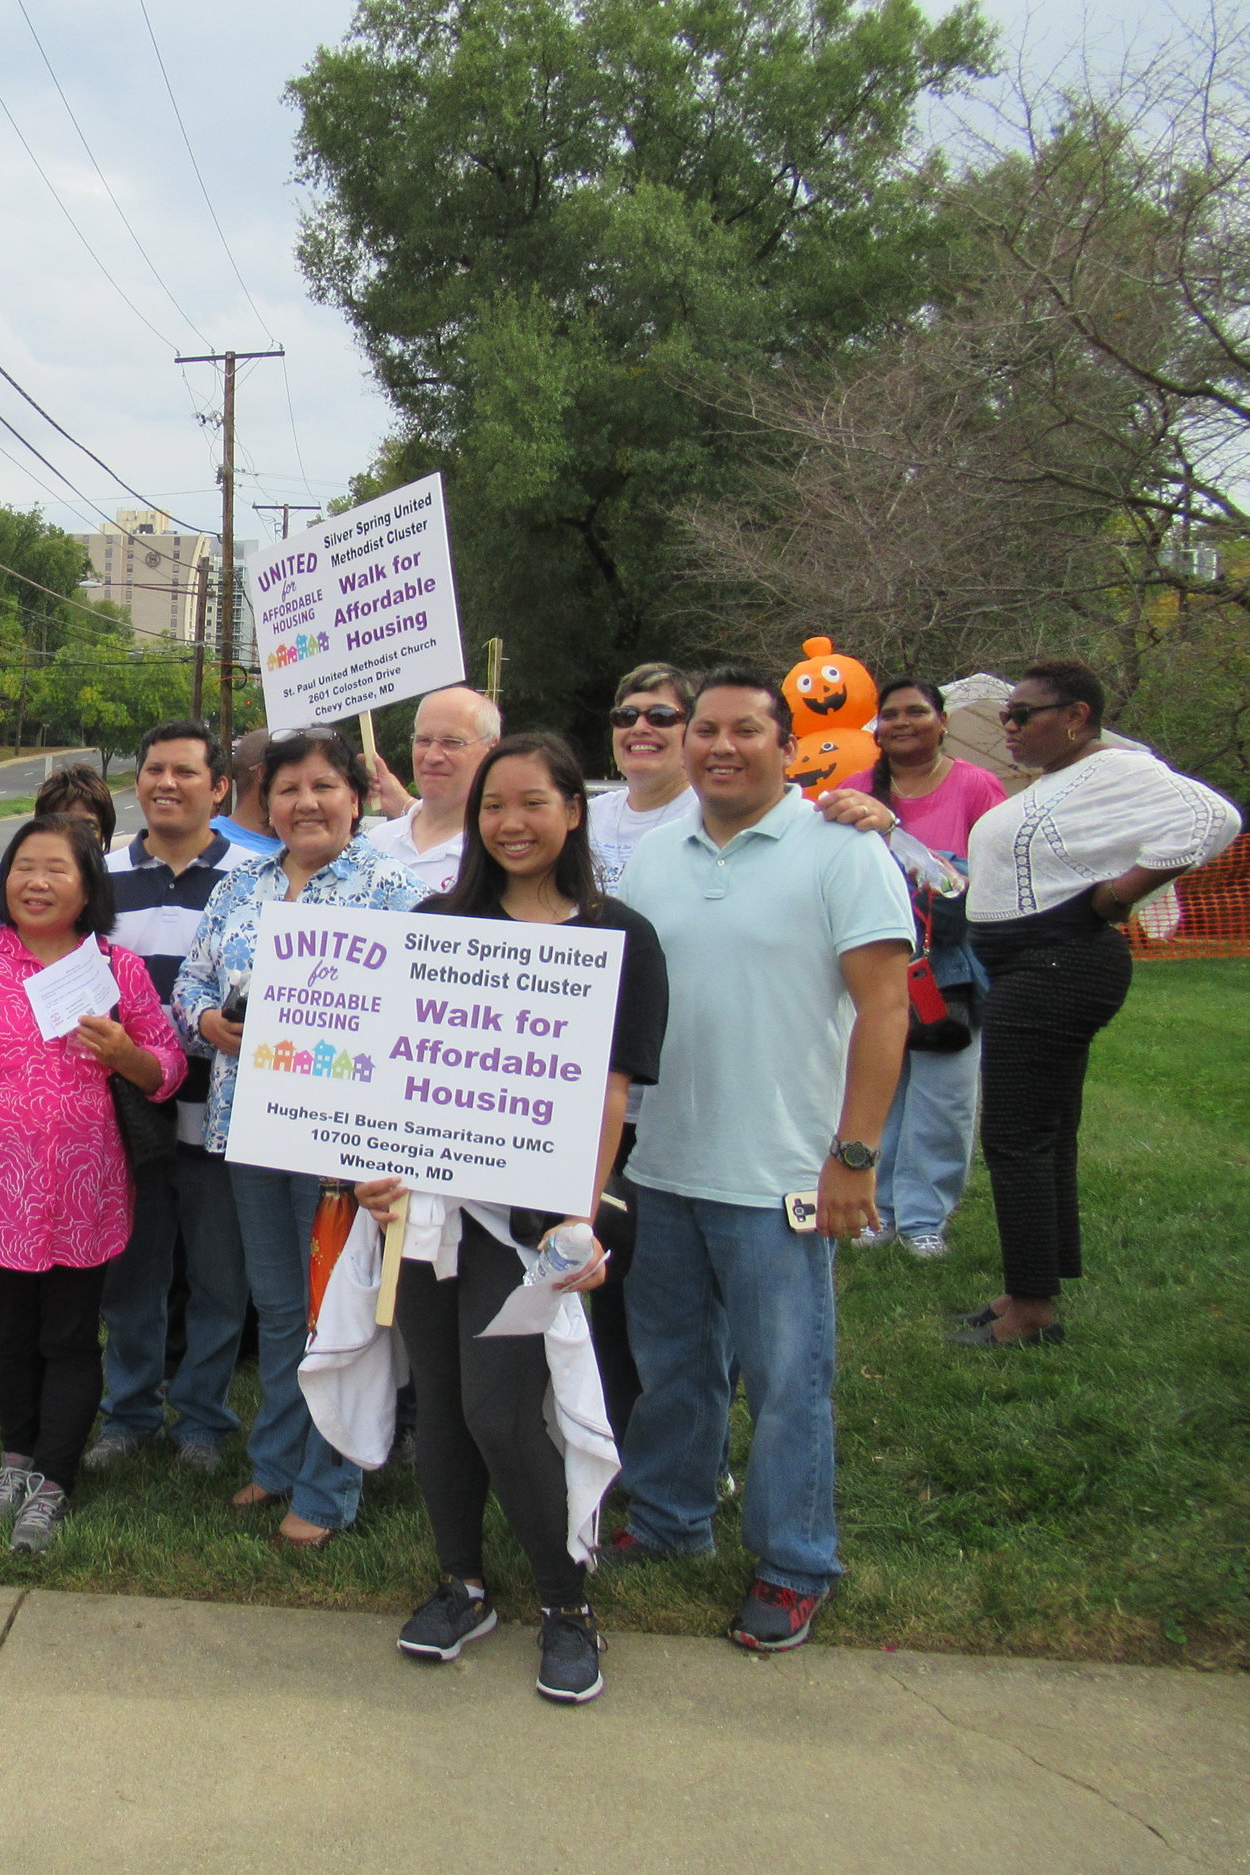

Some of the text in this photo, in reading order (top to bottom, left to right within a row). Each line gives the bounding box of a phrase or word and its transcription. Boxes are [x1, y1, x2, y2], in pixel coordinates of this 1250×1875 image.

[323, 492, 432, 549] Silver Spring United
[330, 519, 428, 568] Methodist Cluster
[258, 552, 318, 592] UNITED
[281, 580, 297, 603] for
[338, 551, 421, 595] Walk for
[262, 589, 323, 624] AFFORDABLE
[273, 608, 315, 635] HOUSING
[334, 577, 436, 628] Affordable
[346, 610, 427, 651] Housing
[283, 637, 437, 698] St. Paul United Methodist Church
[308, 666, 401, 704] 2601 Coloston Drive
[315, 682, 395, 716] Chevy Chase, MD
[273, 930, 387, 970] UNITED
[404, 932, 608, 969] Silver Spring United
[307, 959, 339, 987] for
[410, 962, 592, 997] Methodist Cluster
[263, 985, 382, 1013] AFFORDABLE
[415, 998, 568, 1038] Walk for
[278, 1007, 360, 1032] HOUSING
[388, 1035, 582, 1082] Affordable
[404, 1075, 554, 1126] Housing
[266, 1102, 555, 1153] Hughes-El Buen Samaritano UMC
[311, 1129, 507, 1168] 10700 Georgia Avenue
[340, 1153, 454, 1182] Wheaton, MD
